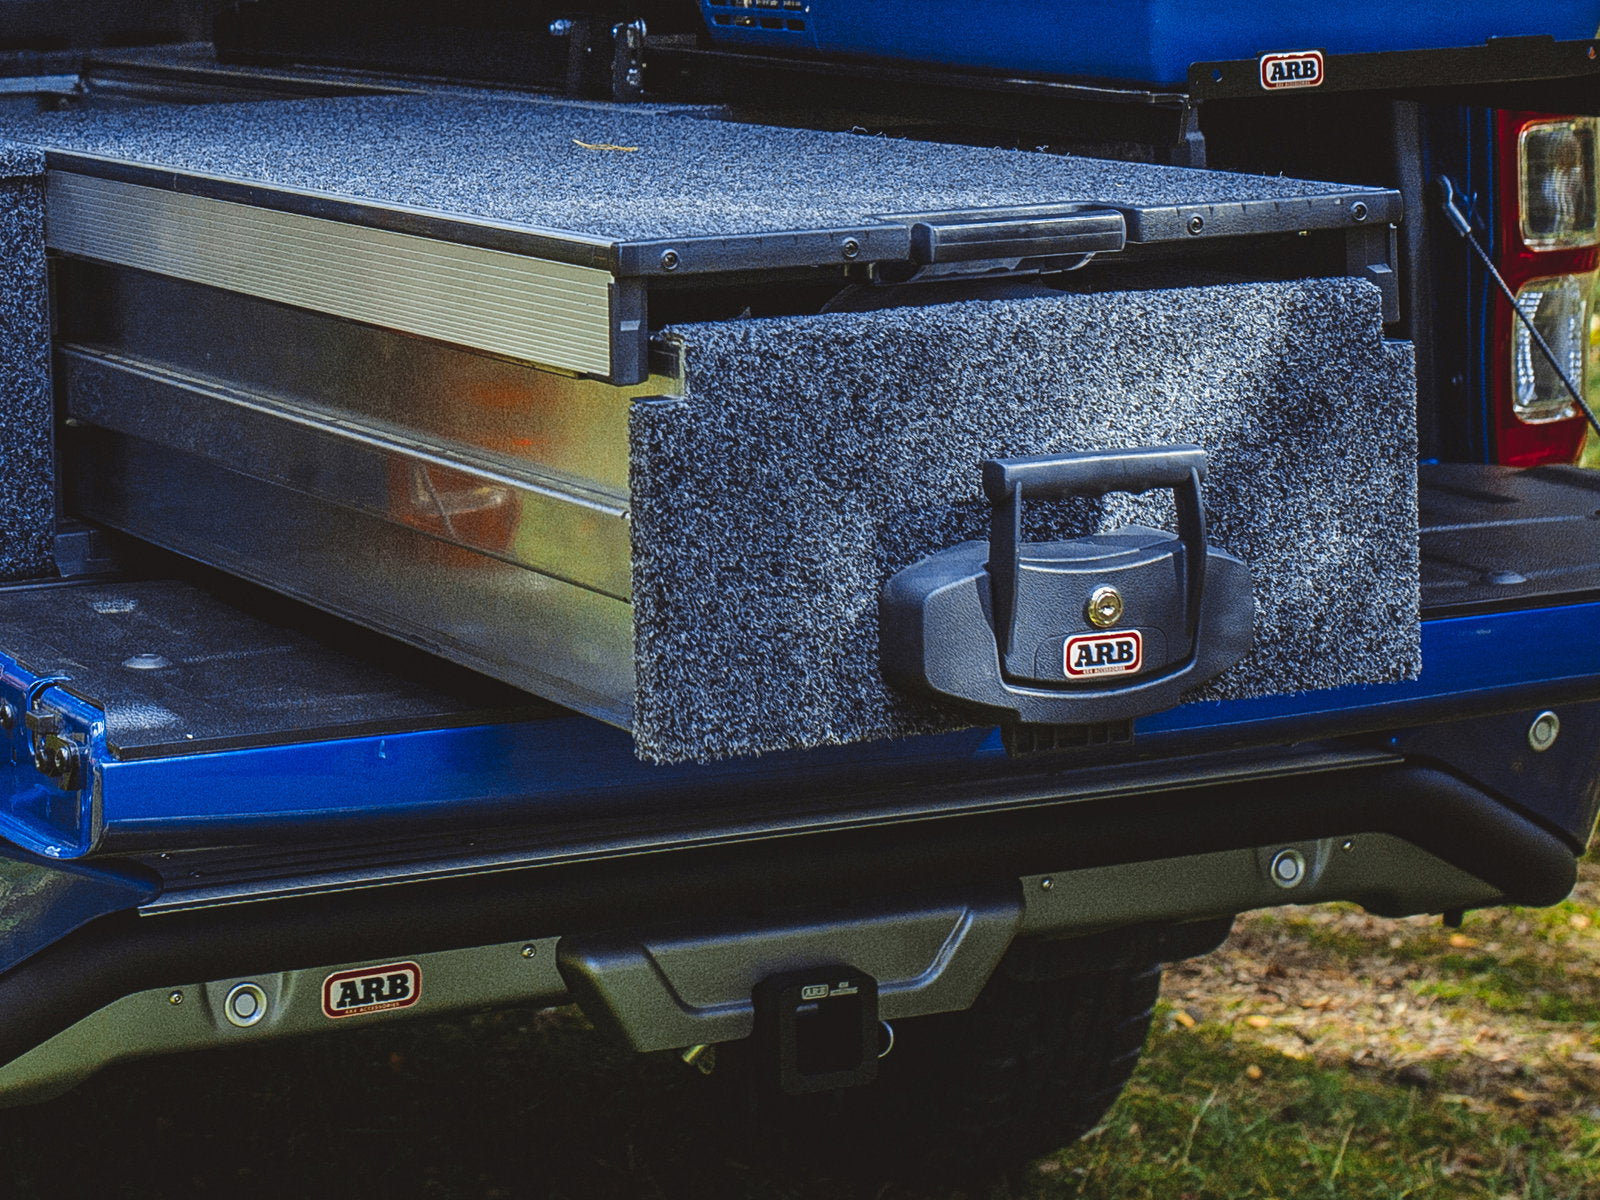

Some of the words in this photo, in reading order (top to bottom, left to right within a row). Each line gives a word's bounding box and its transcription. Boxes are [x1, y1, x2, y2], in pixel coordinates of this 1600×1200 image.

[1270, 60, 1316, 81] ARB
[1074, 641, 1134, 667] ARB
[336, 973, 409, 1008] ARB
